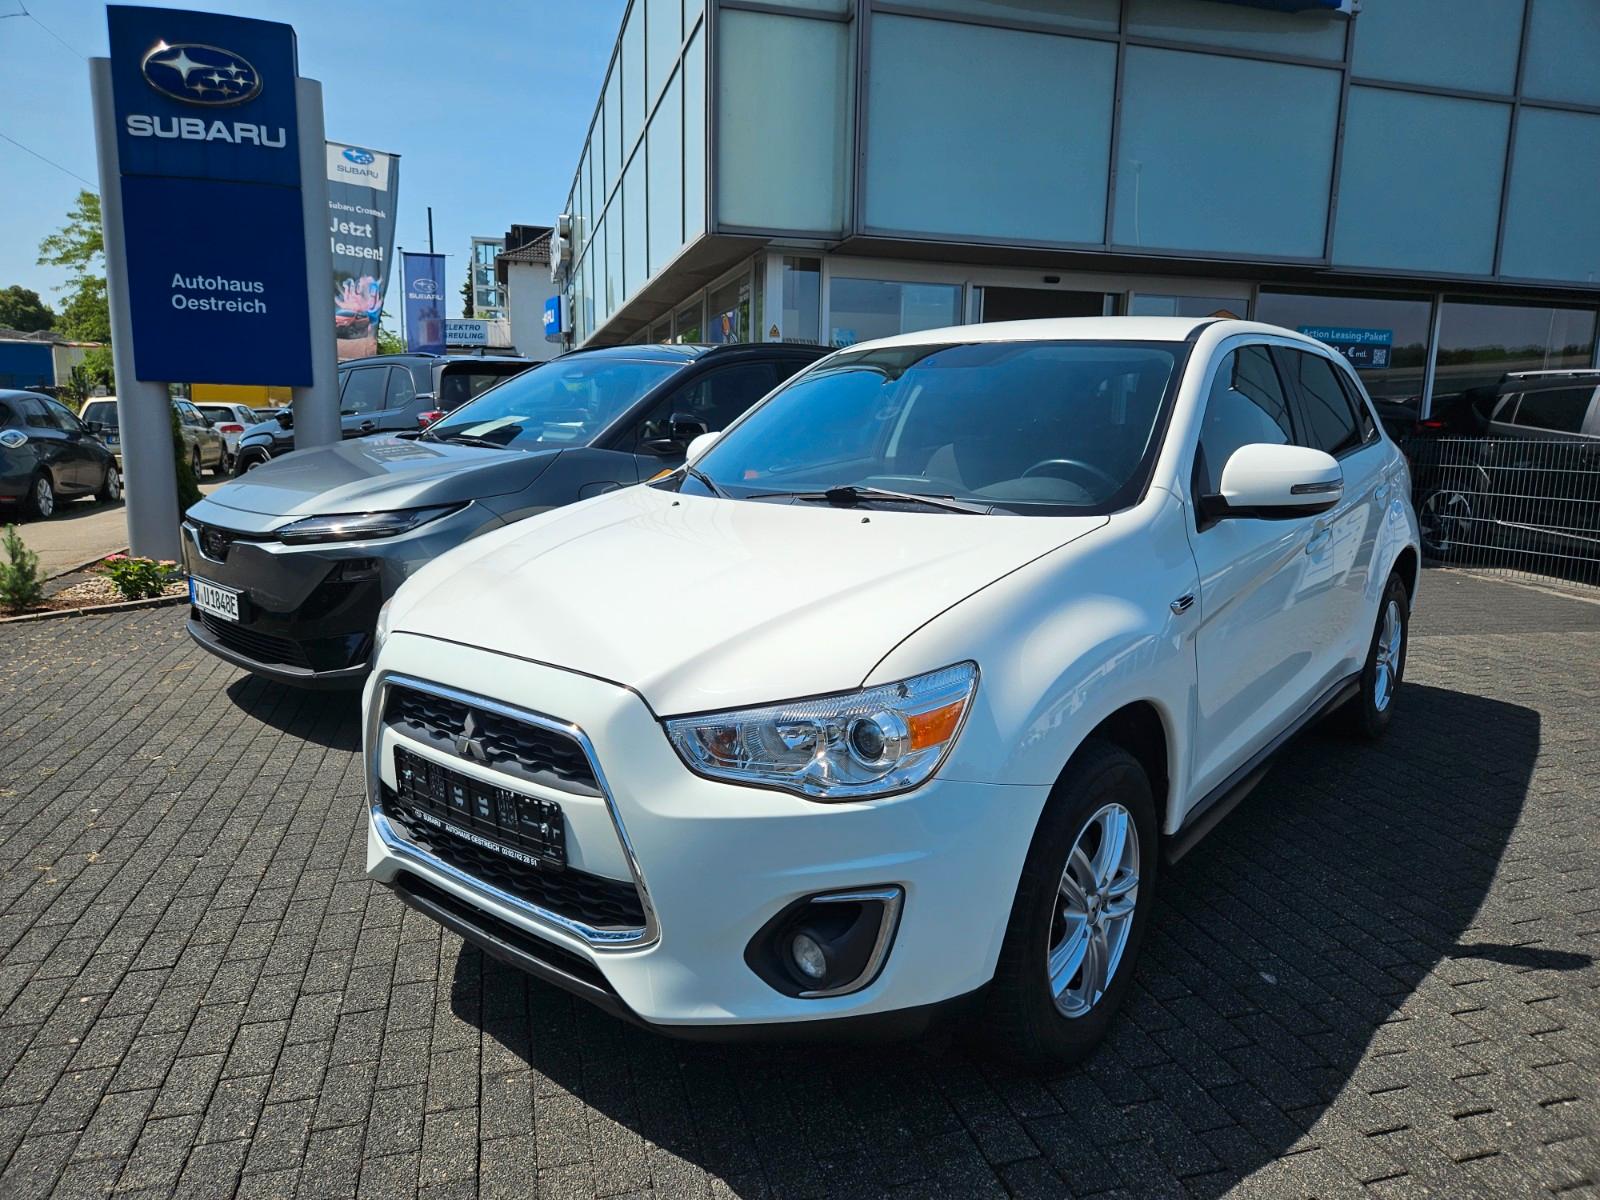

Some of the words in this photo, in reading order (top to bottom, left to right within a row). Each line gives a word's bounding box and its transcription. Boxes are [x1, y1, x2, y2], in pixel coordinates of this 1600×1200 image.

[126, 115, 286, 148] SUBARU
[336, 164, 379, 179] SUBARU
[328, 200, 355, 212] Subaru
[330, 217, 373, 238] Jetzt
[330, 237, 384, 261] leasen!
[171, 273, 265, 294] Autohaus
[171, 294, 267, 314] Oestreich
[408, 292, 444, 301] SUBARU
[445, 824, 471, 840] AUTOHAUS
